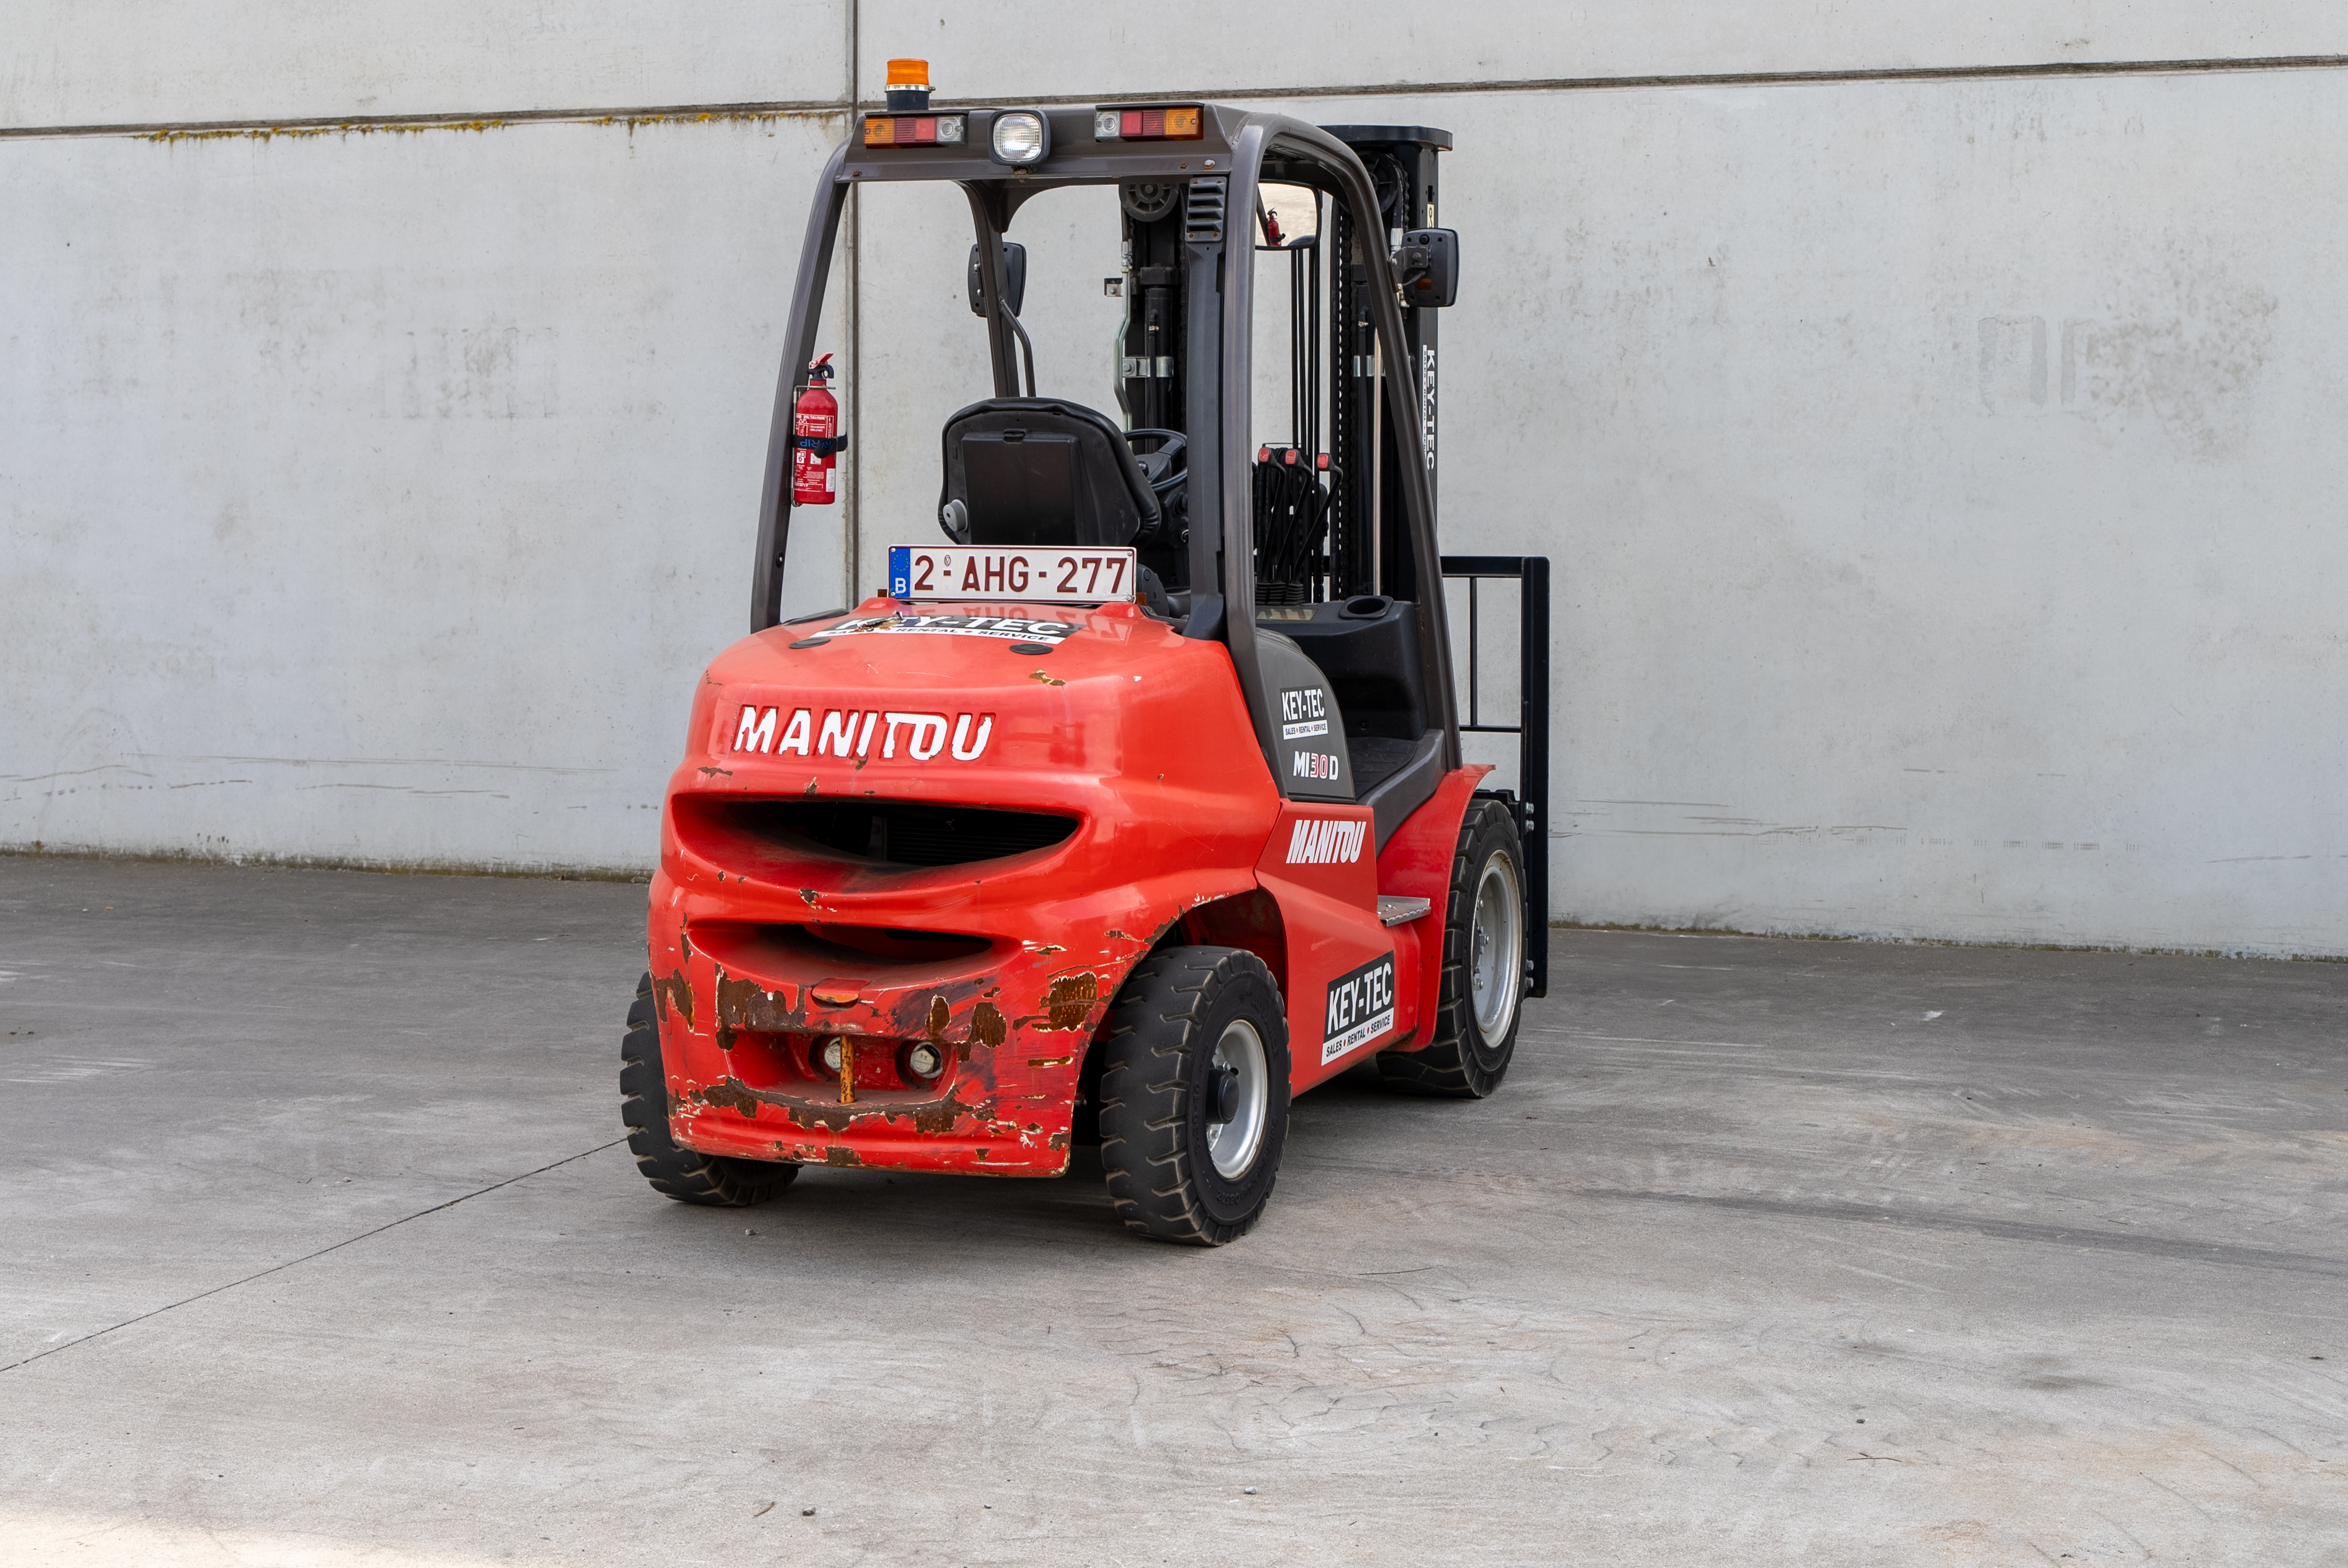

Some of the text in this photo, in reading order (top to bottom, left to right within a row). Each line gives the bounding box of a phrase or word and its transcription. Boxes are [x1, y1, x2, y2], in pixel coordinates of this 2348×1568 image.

[1426, 349, 1435, 471] KEY-TEC
[895, 577, 907, 594] B
[977, 631, 1050, 641] SERVICE
[1281, 688, 1325, 721] KEY-TEC
[732, 705, 994, 762] MANITOU
[1285, 723, 1327, 735] SALES RENTAL SERVICE
[1285, 819, 1367, 864] MANITOU
[1327, 962, 1392, 1035] KEY-TEC
[1326, 1014, 1391, 1057] SALES RENTAL SERVICE
